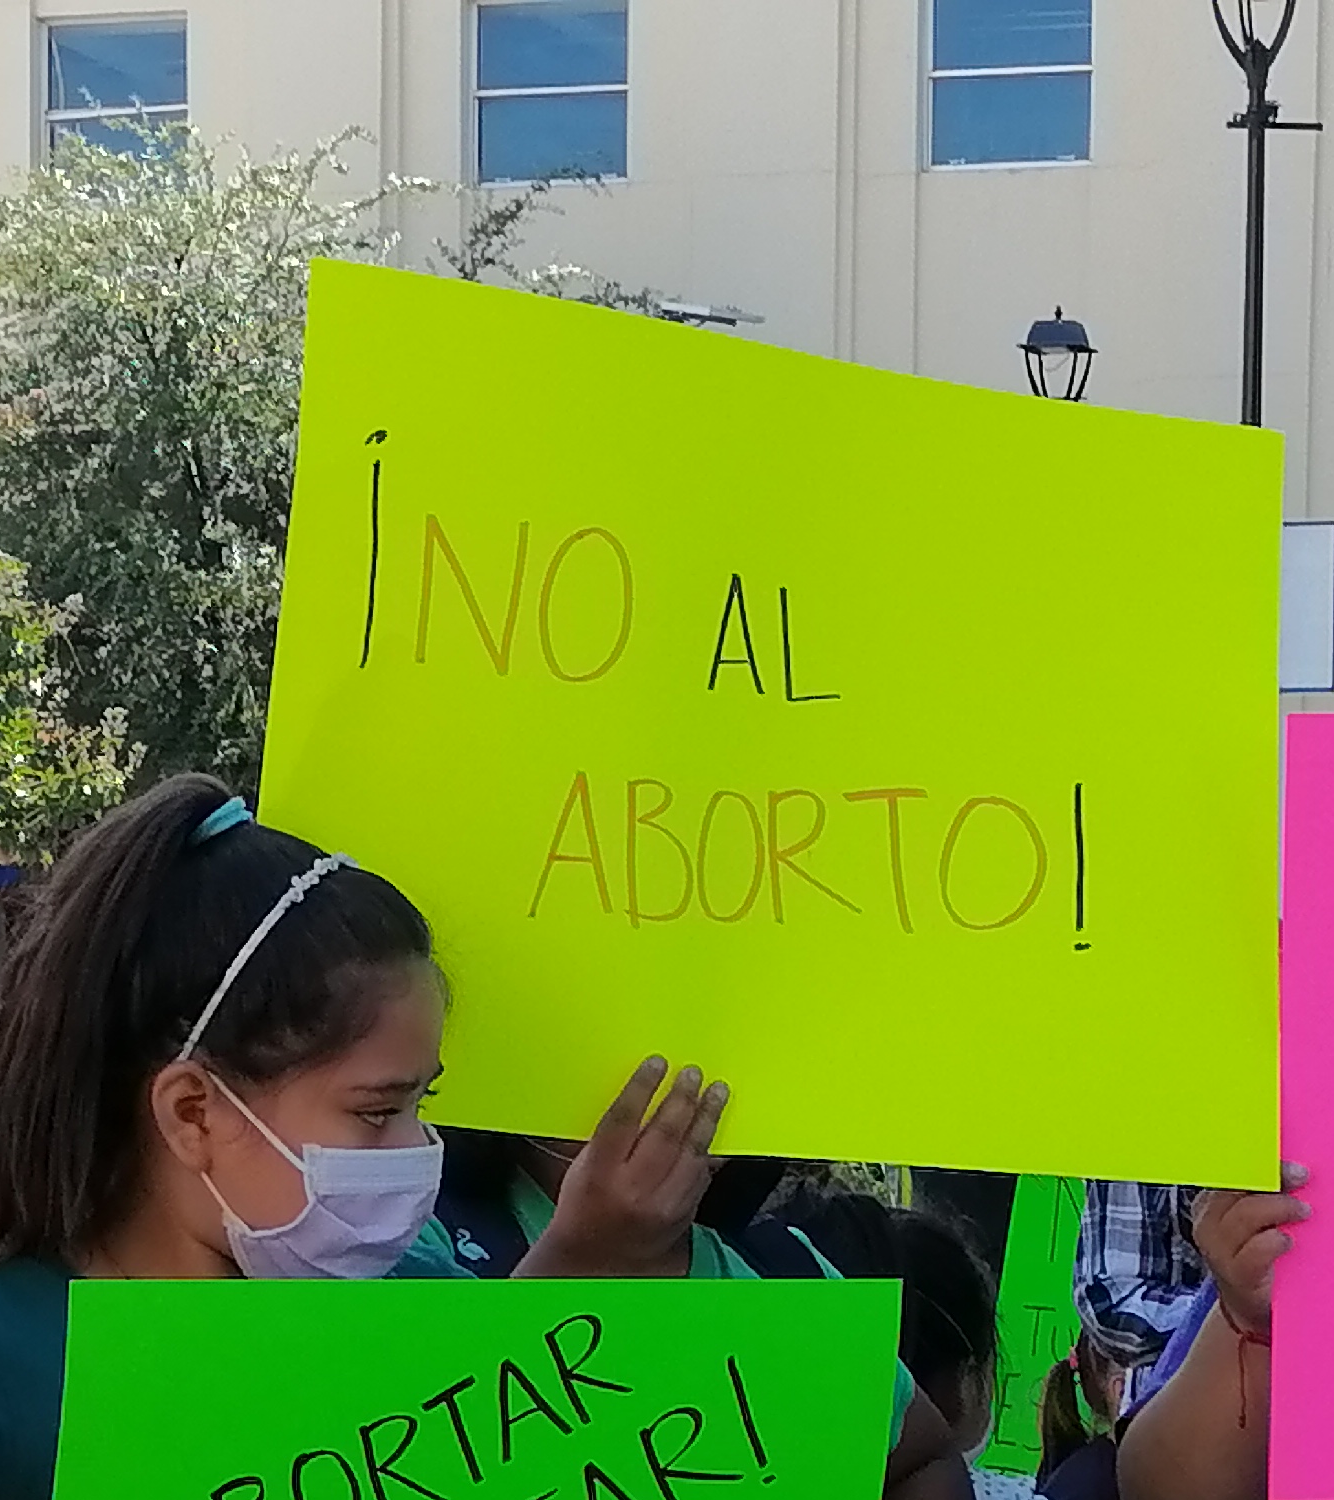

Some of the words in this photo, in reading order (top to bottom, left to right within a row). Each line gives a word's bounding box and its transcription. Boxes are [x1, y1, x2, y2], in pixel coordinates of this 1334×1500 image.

[358, 429, 635, 683] ¡NO
[707, 572, 842, 702] AL
[528, 770, 1093, 952] ABORTO!
